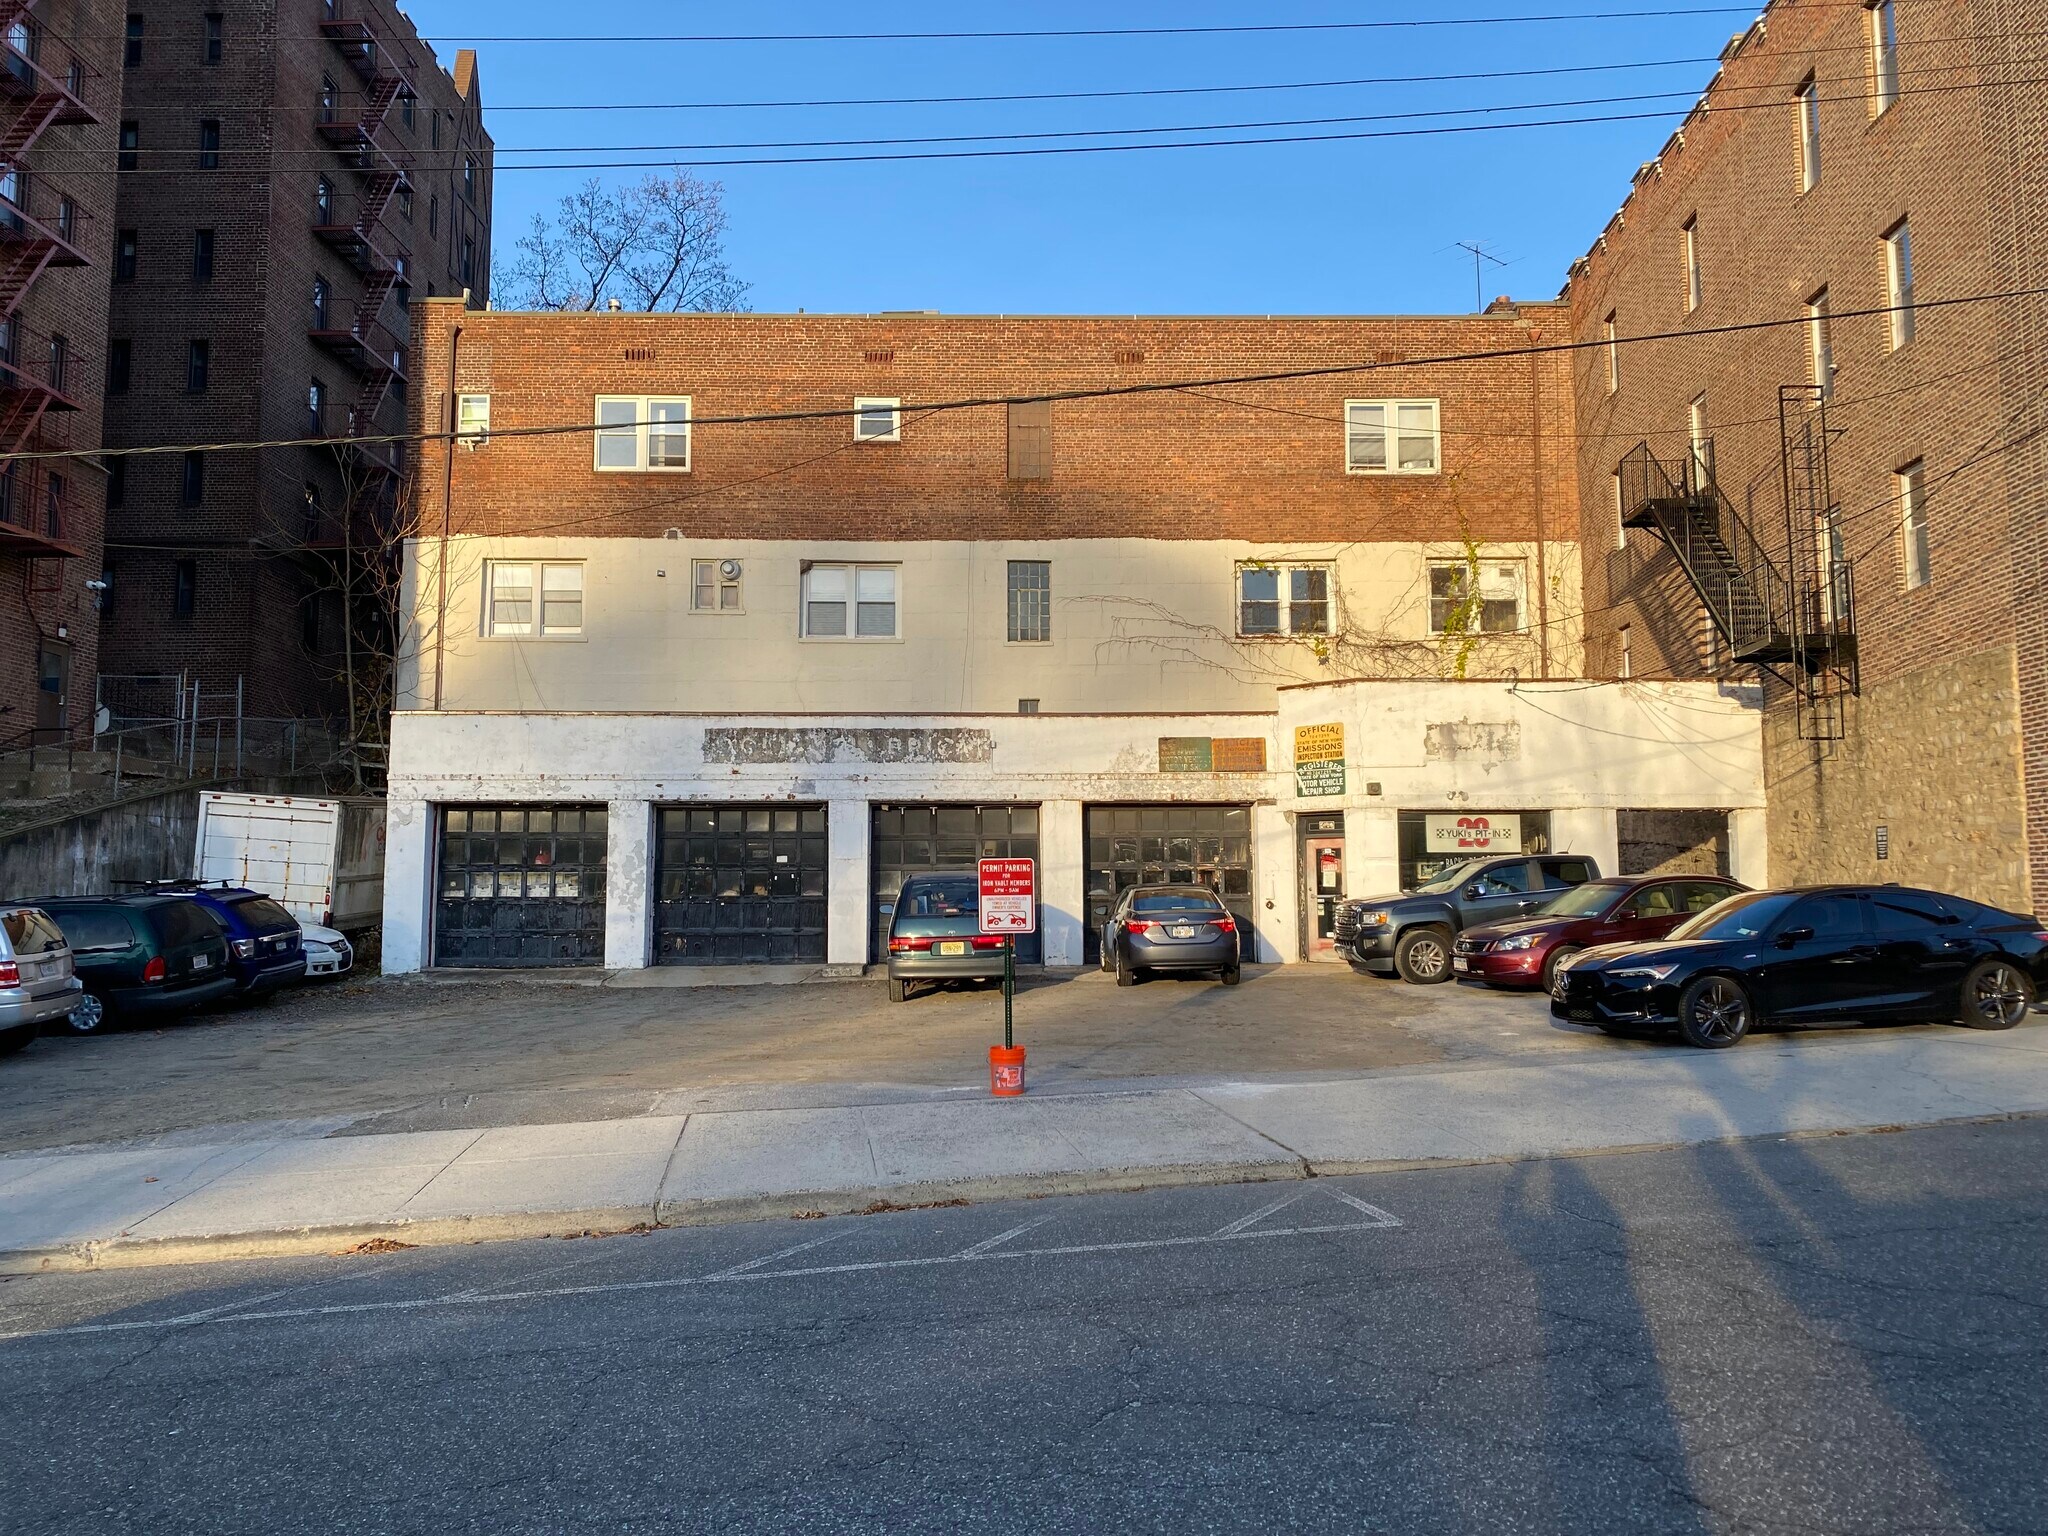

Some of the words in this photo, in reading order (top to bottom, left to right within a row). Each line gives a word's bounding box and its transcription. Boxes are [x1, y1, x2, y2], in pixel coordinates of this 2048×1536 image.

[1300, 725, 1340, 738] OFFICIAL
[1297, 742, 1343, 753] EMISSIONS
[1297, 752, 1323, 761] INSPECTION
[1324, 750, 1343, 759] STATION
[1318, 777, 1344, 787] VEHICLE
[1324, 786, 1341, 795] SHOP
[1446, 829, 1472, 838] YUKI's
[982, 865, 1003, 873] PERMIT
[1004, 864, 1031, 873] PARKING
